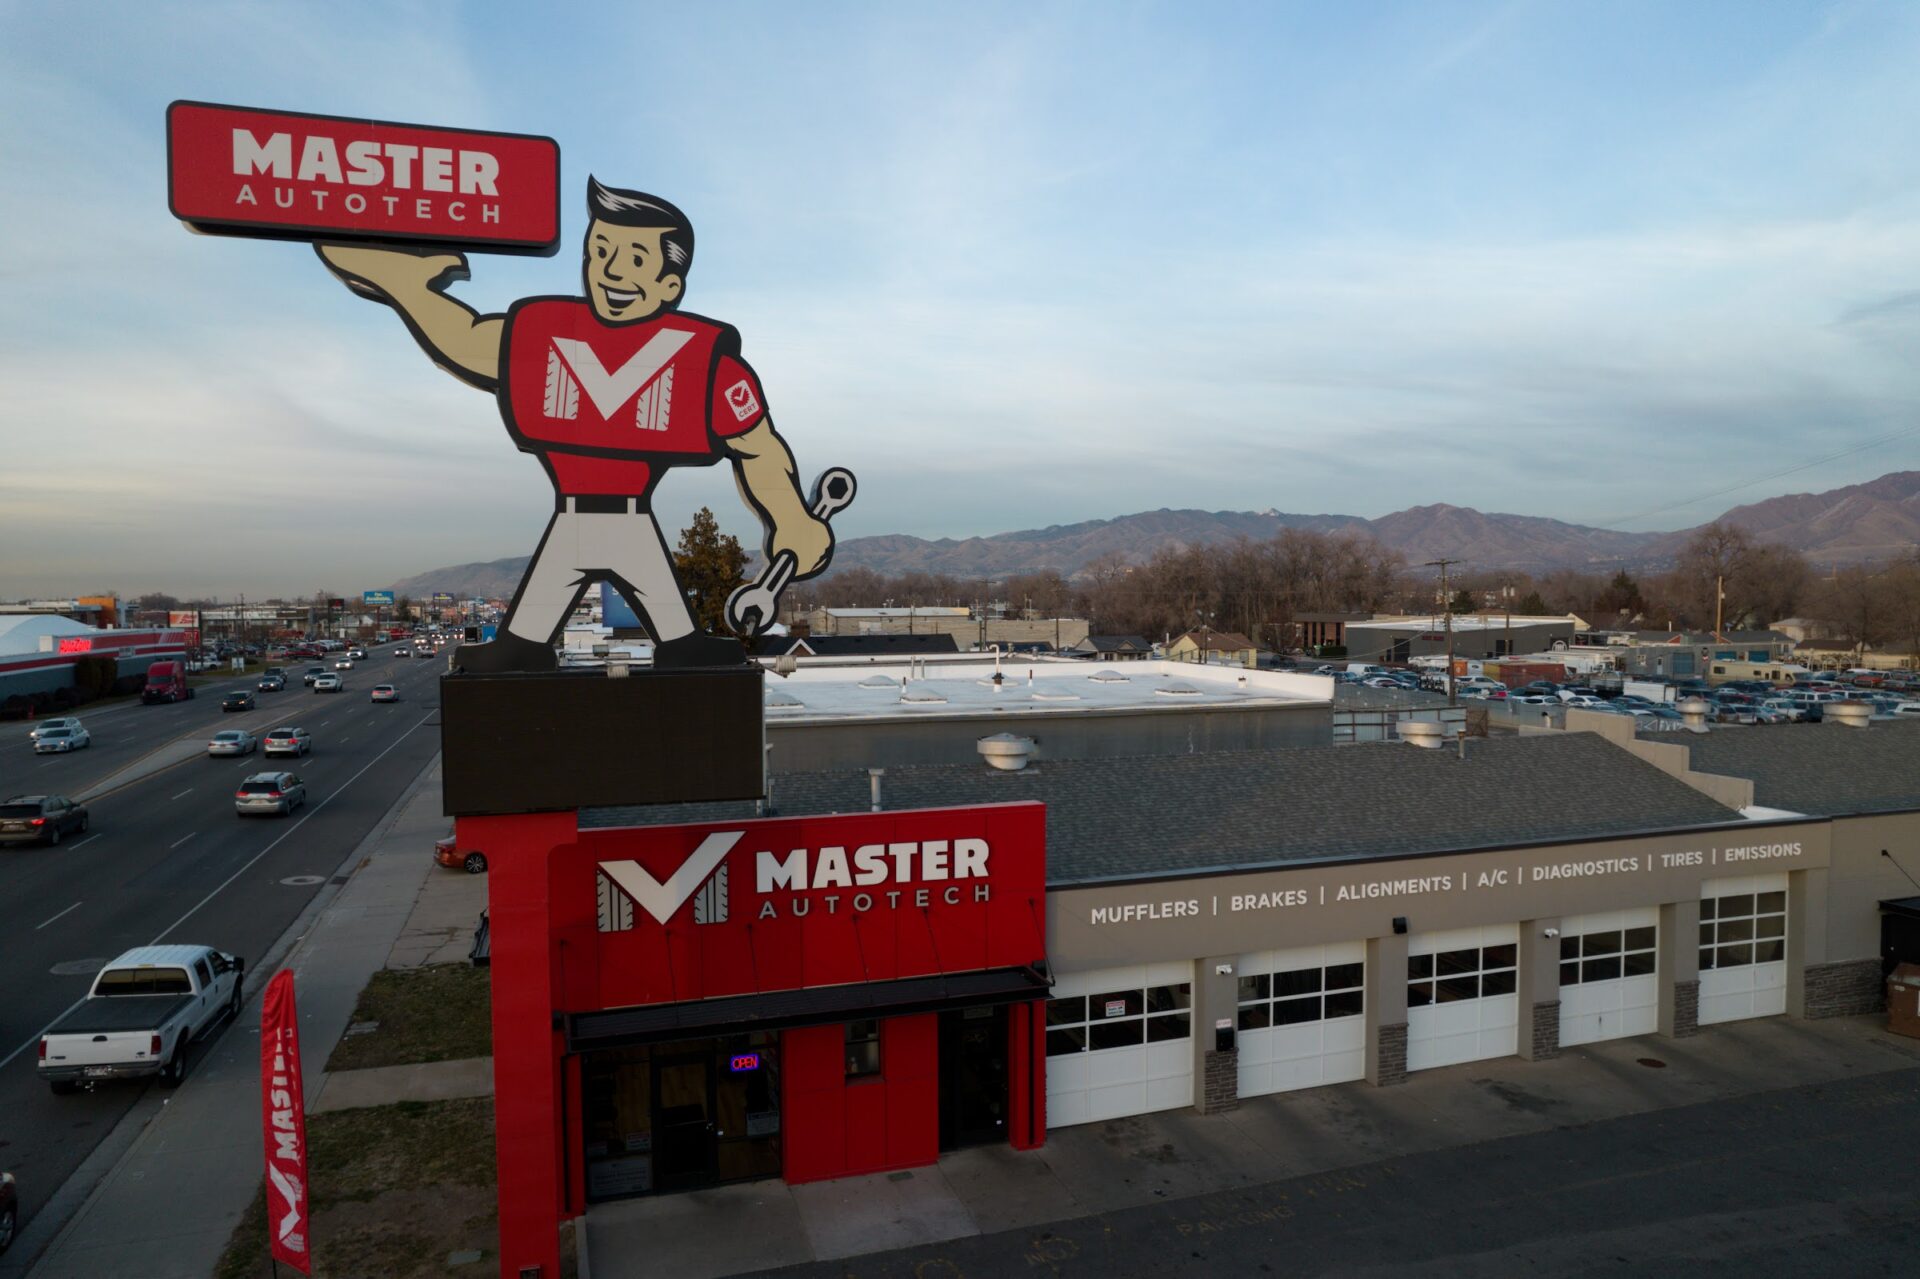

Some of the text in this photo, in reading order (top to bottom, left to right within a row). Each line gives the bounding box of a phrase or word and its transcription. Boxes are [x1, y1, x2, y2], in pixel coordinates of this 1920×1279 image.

[232, 128, 500, 197] MASTER
[236, 184, 500, 224] AUTOTECH
[738, 403, 757, 418] CERT
[756, 837, 990, 894] MASTER
[1091, 899, 1199, 925] MUFFLERS
[1231, 889, 1308, 912] BRAKES
[1336, 875, 1452, 901] ALIGNMENTS
[1477, 869, 1508, 888] A/C
[1532, 857, 1639, 882] DIAGNOSTICS
[1661, 851, 1703, 869] TIRES
[1725, 842, 1802, 862] EMISSIONS
[759, 884, 990, 919] AUTOTECH
[733, 1055, 757, 1069] OPEN
[270, 1026, 298, 1160] MAS
